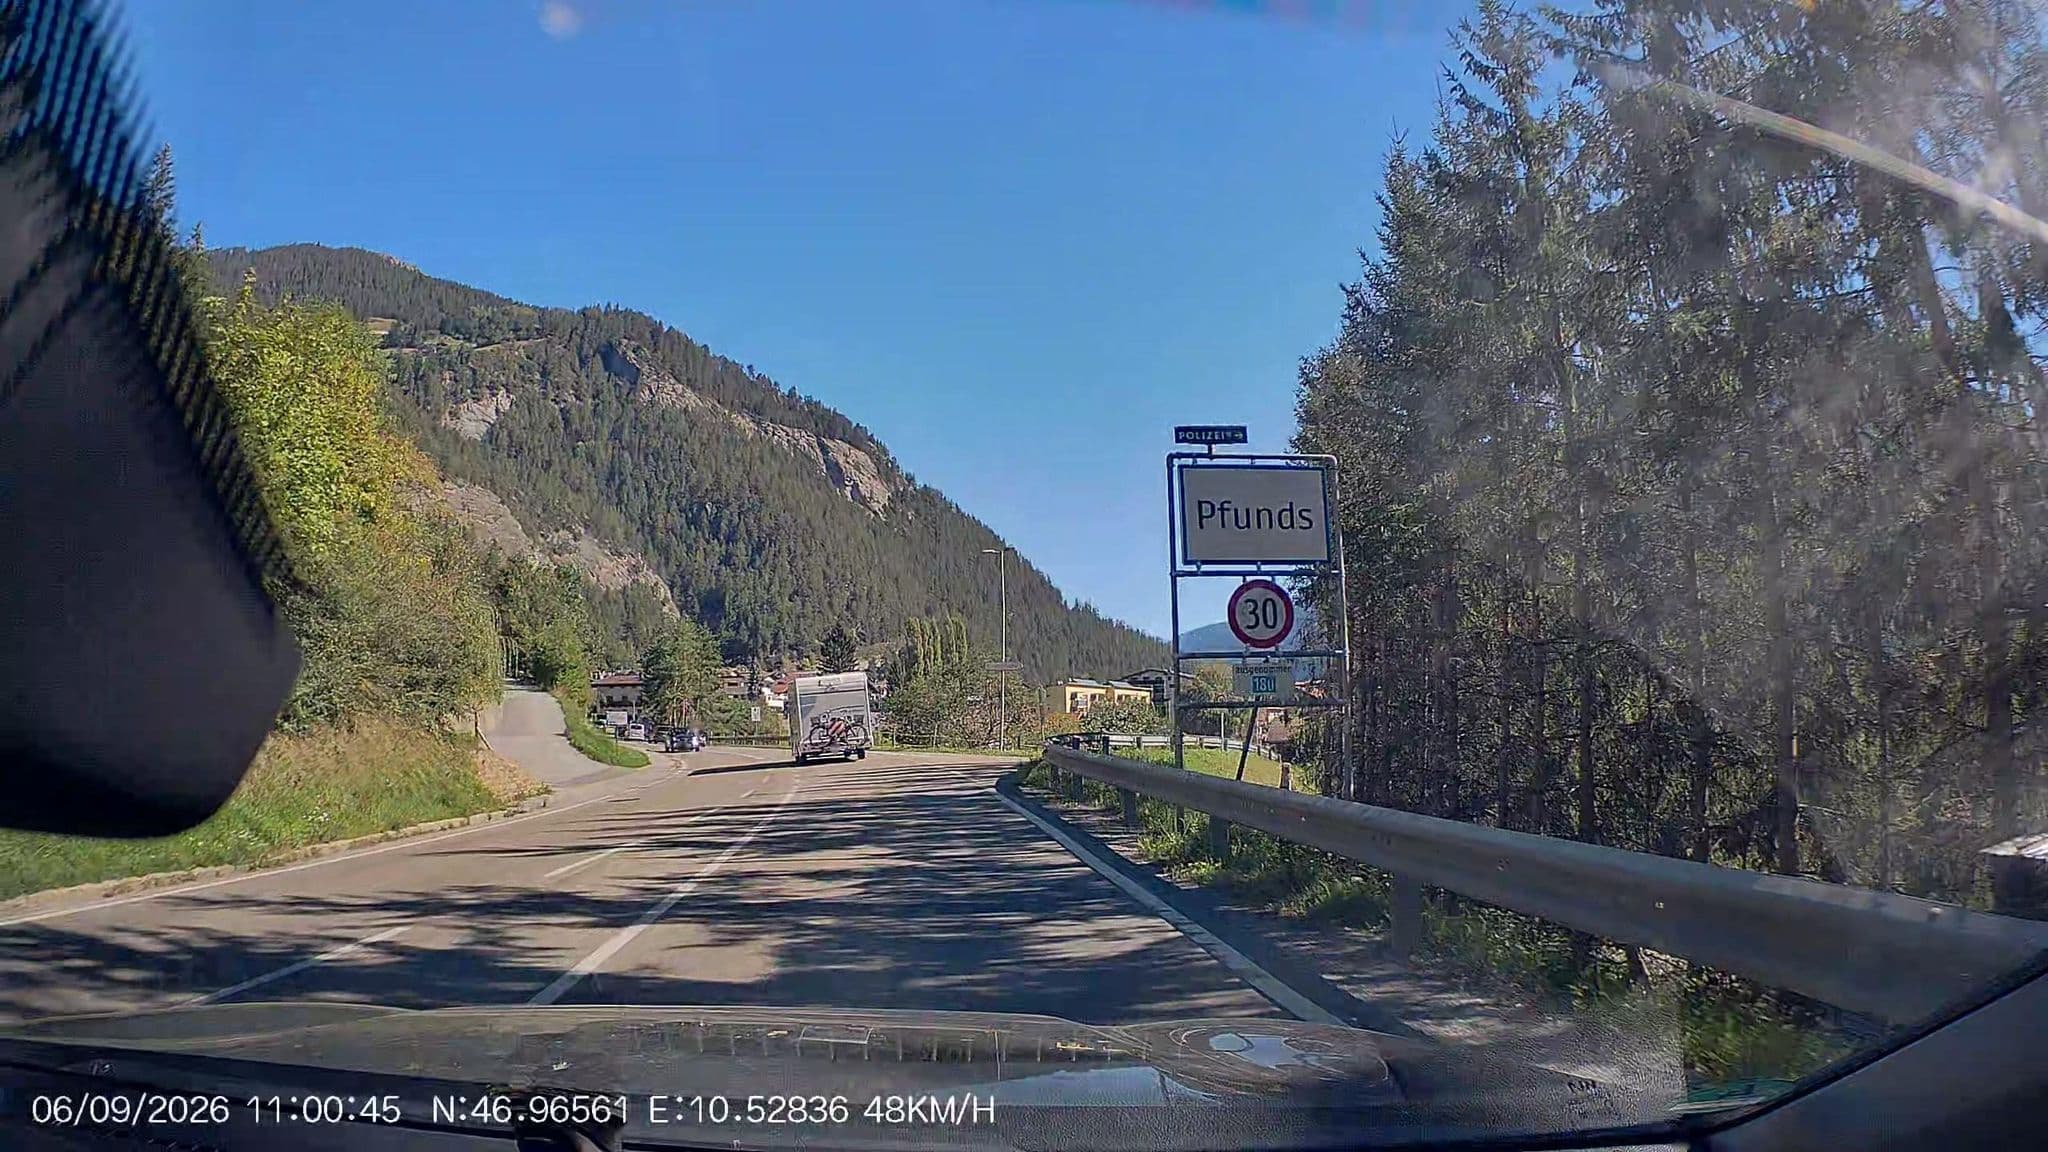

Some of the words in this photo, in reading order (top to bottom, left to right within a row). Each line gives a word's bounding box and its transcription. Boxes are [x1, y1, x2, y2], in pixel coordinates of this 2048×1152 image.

[1178, 431, 1225, 440] POLIZEI
[1198, 499, 1314, 530] Pfunds
[1243, 597, 1278, 630] 30
